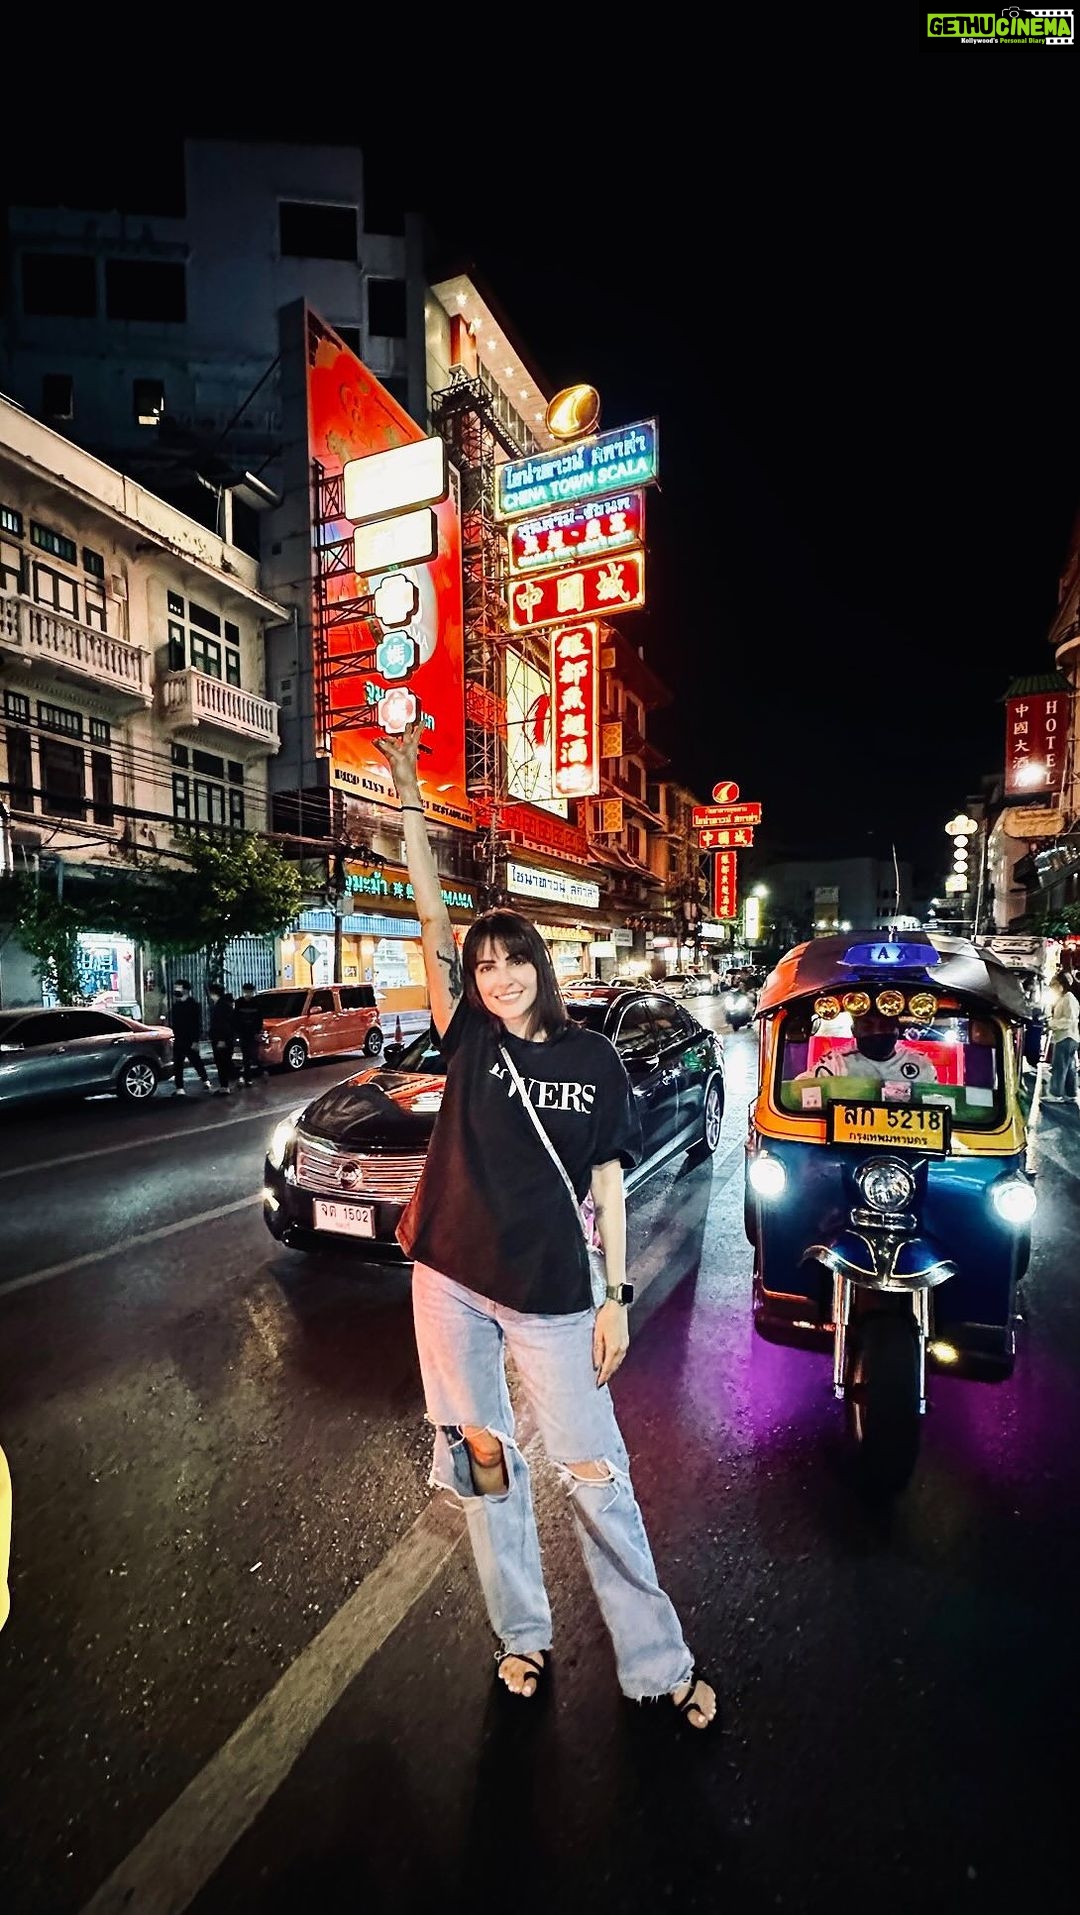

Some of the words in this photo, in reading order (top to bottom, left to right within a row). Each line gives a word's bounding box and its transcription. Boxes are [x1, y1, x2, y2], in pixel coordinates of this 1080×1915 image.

[503, 485, 547, 510] CHINA
[550, 471, 595, 498] TOWN
[597, 457, 649, 483] SCALA
[1044, 700, 1059, 785] HOTEL
[887, 1109, 941, 1131] 5218
[343, 1207, 370, 1223] 1502
